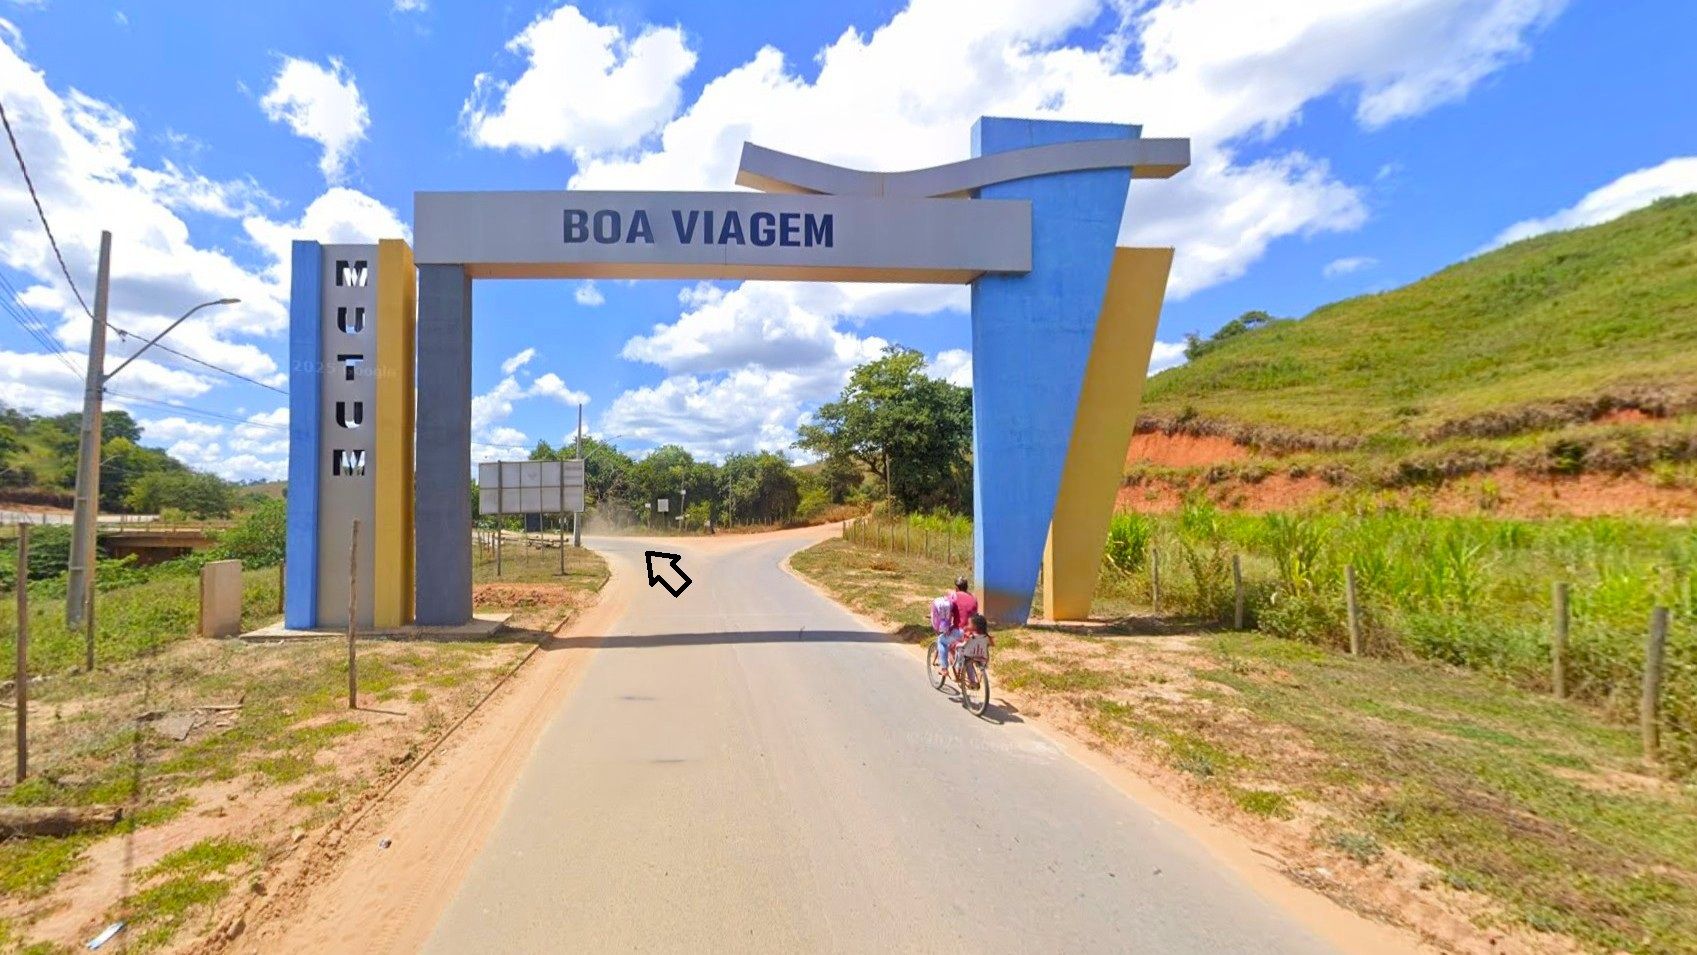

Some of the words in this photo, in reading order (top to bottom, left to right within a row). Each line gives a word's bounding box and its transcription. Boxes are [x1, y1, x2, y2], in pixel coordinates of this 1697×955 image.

[563, 209, 654, 244] BOA
[671, 210, 834, 248] VIAGEM
[333, 260, 368, 476] MUTUM
